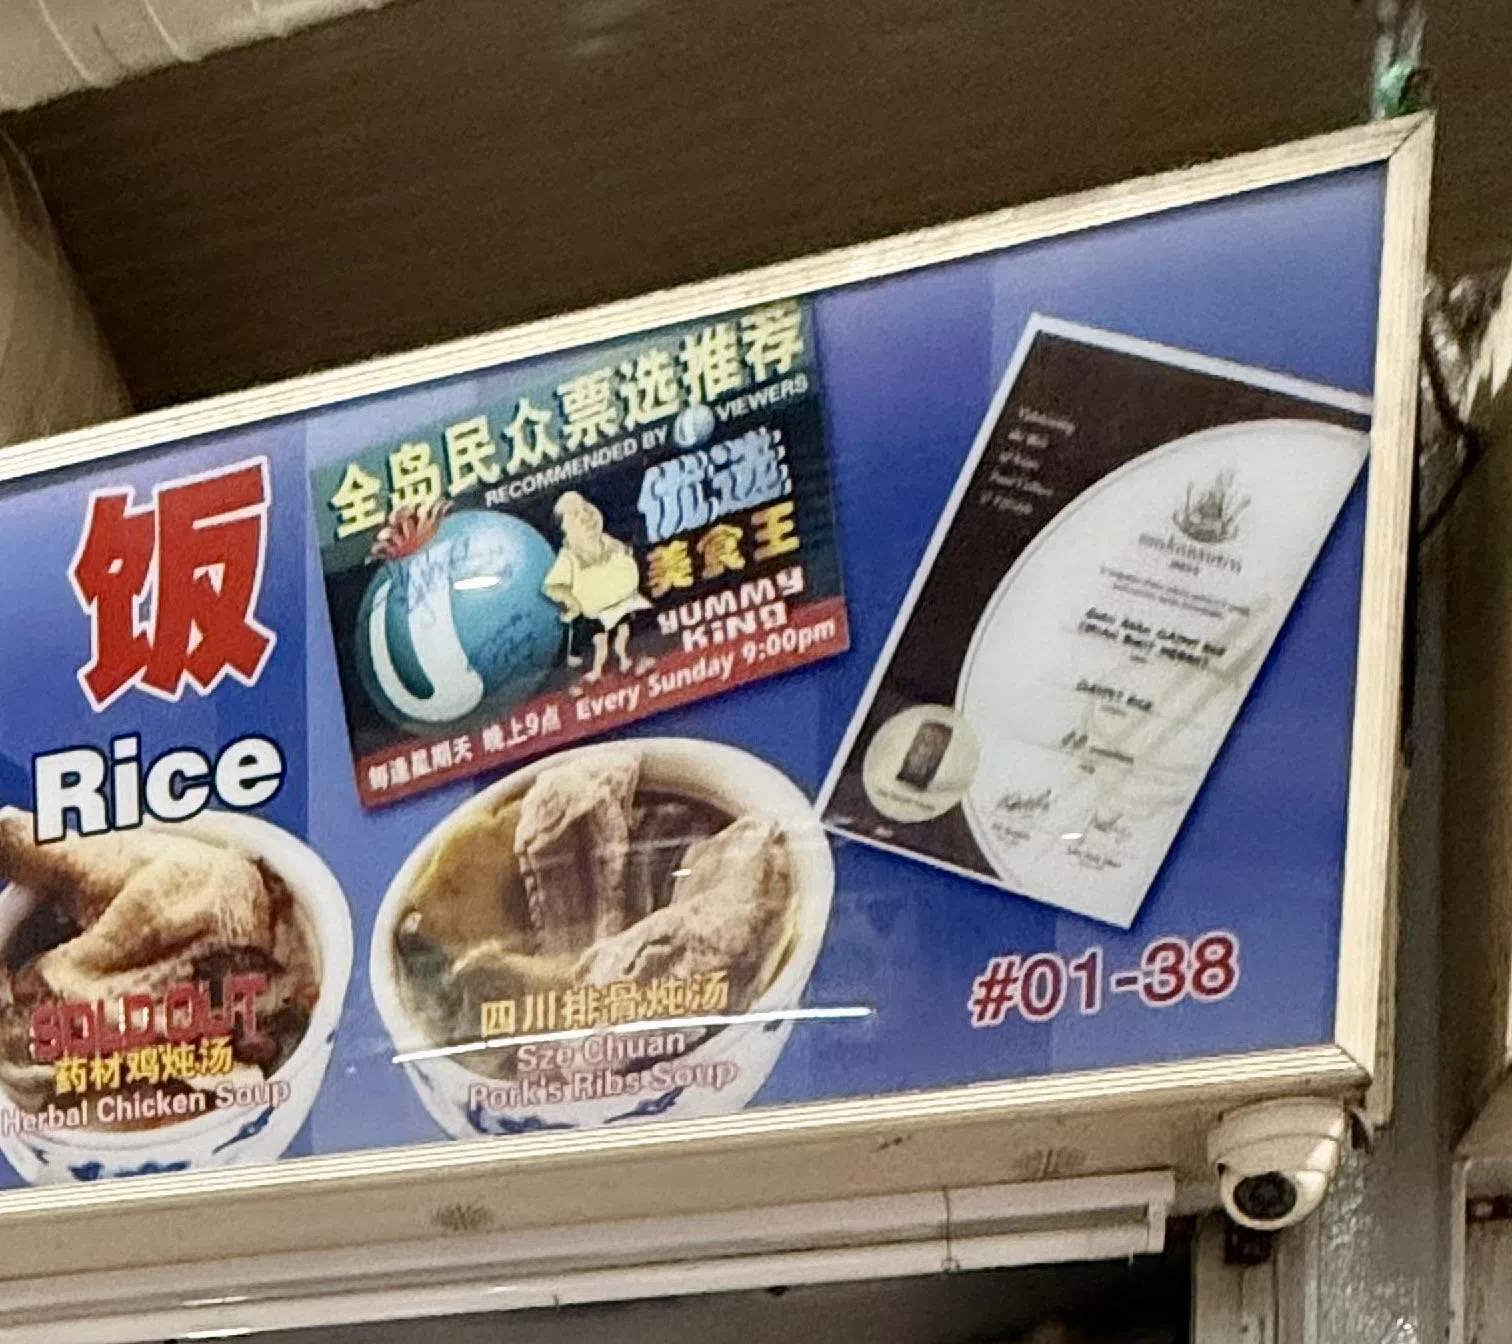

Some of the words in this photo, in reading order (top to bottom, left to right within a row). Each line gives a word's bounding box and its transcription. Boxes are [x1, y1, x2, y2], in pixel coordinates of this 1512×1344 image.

[332, 302, 804, 540] 全岛民众票选推荐
[485, 437, 637, 507] RECOMMENDED
[642, 424, 668, 450] BY
[715, 374, 809, 422] VIEWERS
[646, 500, 800, 598] 美食王
[577, 681, 640, 723] Every
[647, 654, 734, 700] Sunday
[741, 616, 837, 669] 9:00pm
[32, 734, 284, 849] Rice
[29, 988, 158, 1061] SOLD
[163, 973, 268, 1040] OUT
[968, 932, 1240, 1028] #01-38
[55, 1037, 235, 1095] 药材鸡炖汤
[468, 1073, 566, 1111] Pork's
[570, 1064, 640, 1101] Ribs
[642, 1060, 738, 1095] Soup
[516, 1044, 576, 1072] Sze
[582, 1028, 687, 1066] Chuan
[1, 1099, 89, 1137] Herbal
[96, 1090, 207, 1123] Chicken
[215, 1080, 291, 1112] Soup
